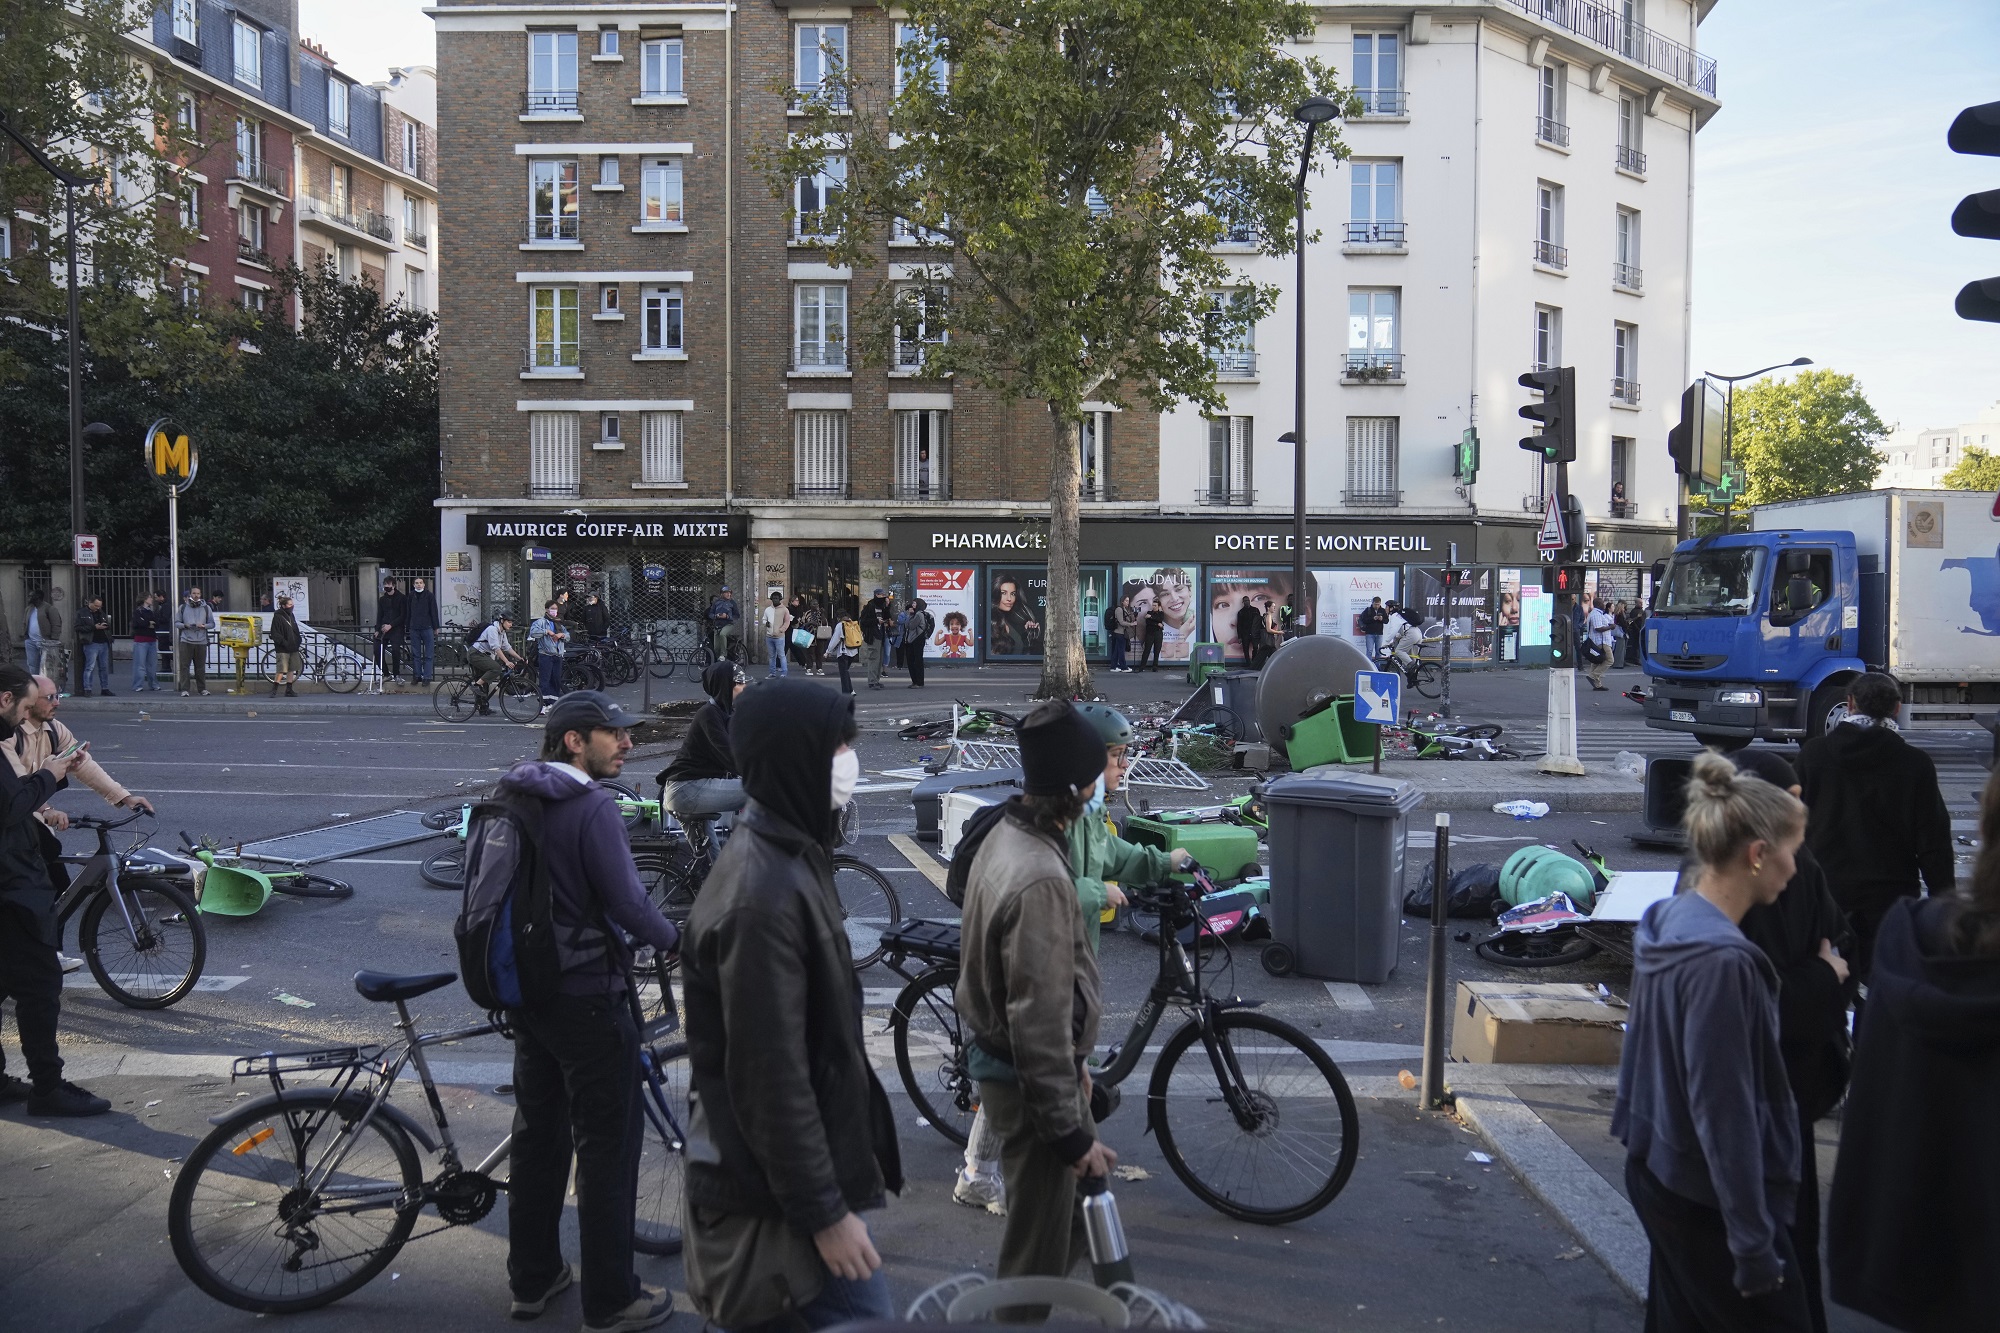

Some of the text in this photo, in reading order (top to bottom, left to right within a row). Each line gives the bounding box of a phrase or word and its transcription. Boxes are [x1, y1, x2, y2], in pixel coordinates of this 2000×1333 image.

[154, 431, 190, 477] M
[486, 523, 728, 537] MAURICE COIFF-AIR MIXTE
[1214, 534, 1279, 550] PORTE
[1317, 535, 1431, 551] MONTREUIL
[1591, 549, 1645, 564] MONTREUIL
[1349, 576, 1384, 589] Avène
[1426, 593, 1440, 606] TUÉ
[1451, 597, 1458, 606] 5
